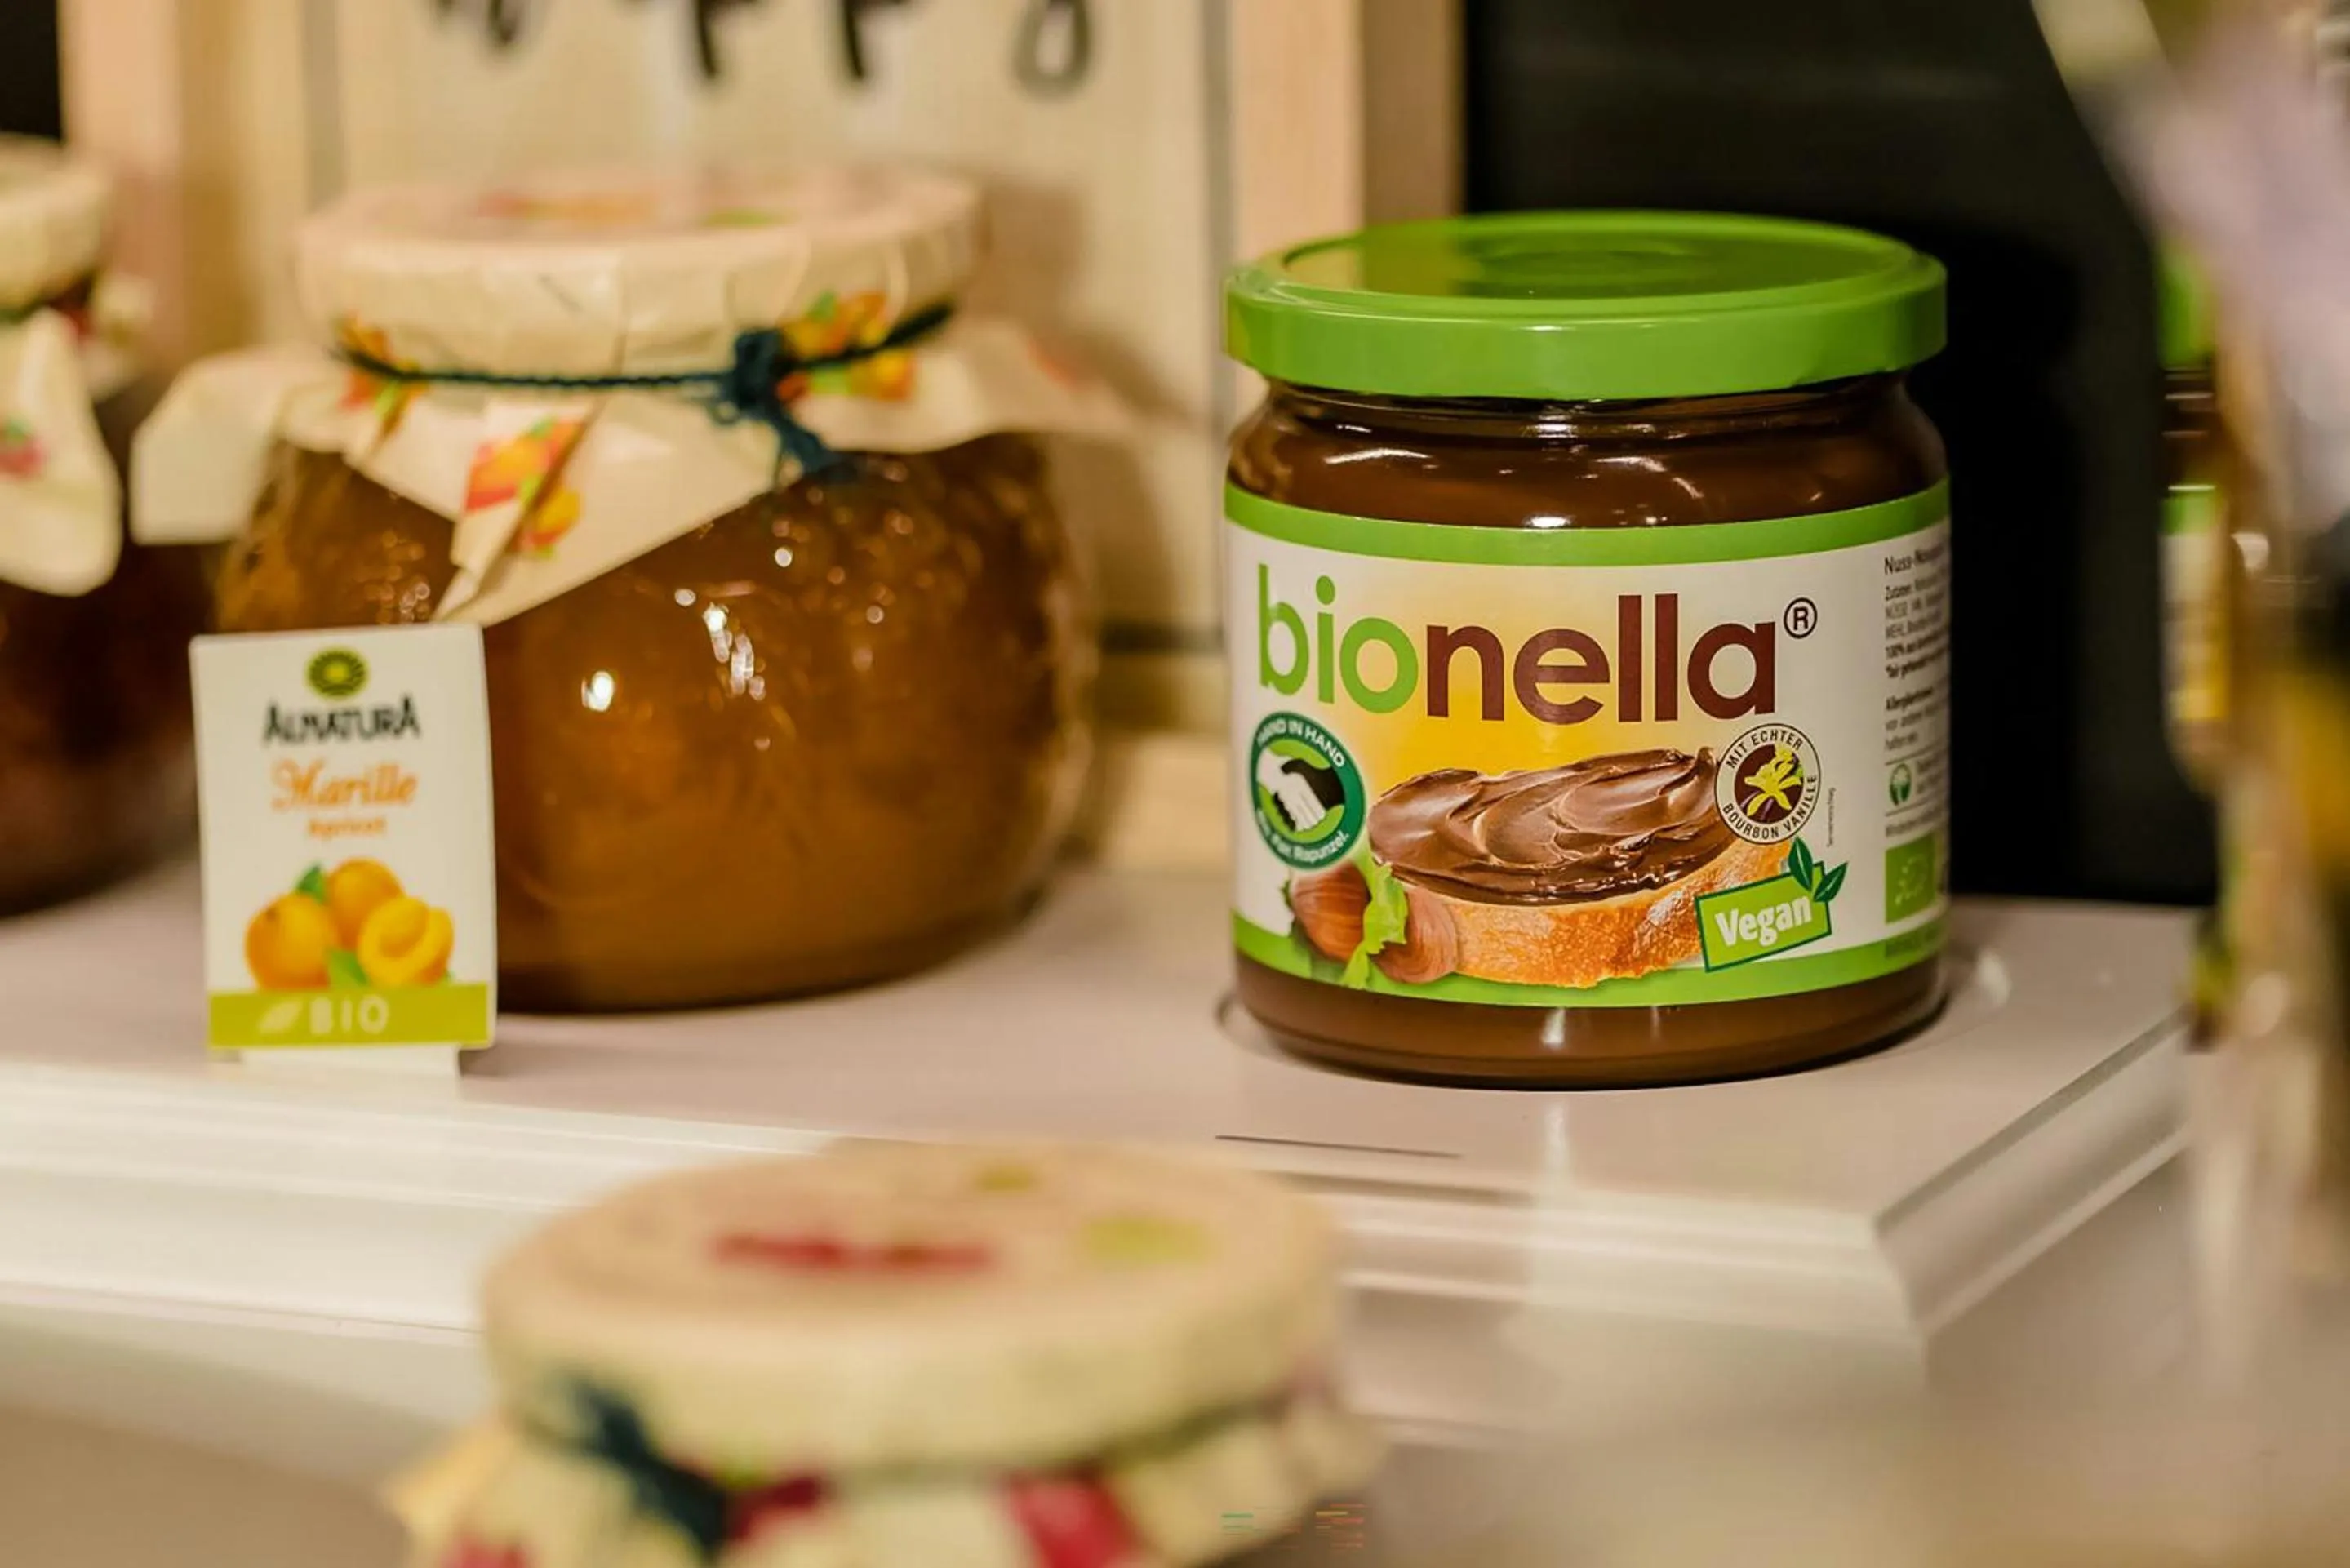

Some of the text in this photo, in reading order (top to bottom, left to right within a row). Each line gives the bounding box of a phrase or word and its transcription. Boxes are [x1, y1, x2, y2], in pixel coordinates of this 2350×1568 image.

[1305, 725, 1345, 767] HAND
[1726, 729, 1803, 769] MIT ECHTER
[1722, 802, 1779, 840] BOURBON
[1783, 776, 1817, 832] VANILLE
[1715, 895, 1812, 946] Vegan
[309, 994, 390, 1035] BIO
